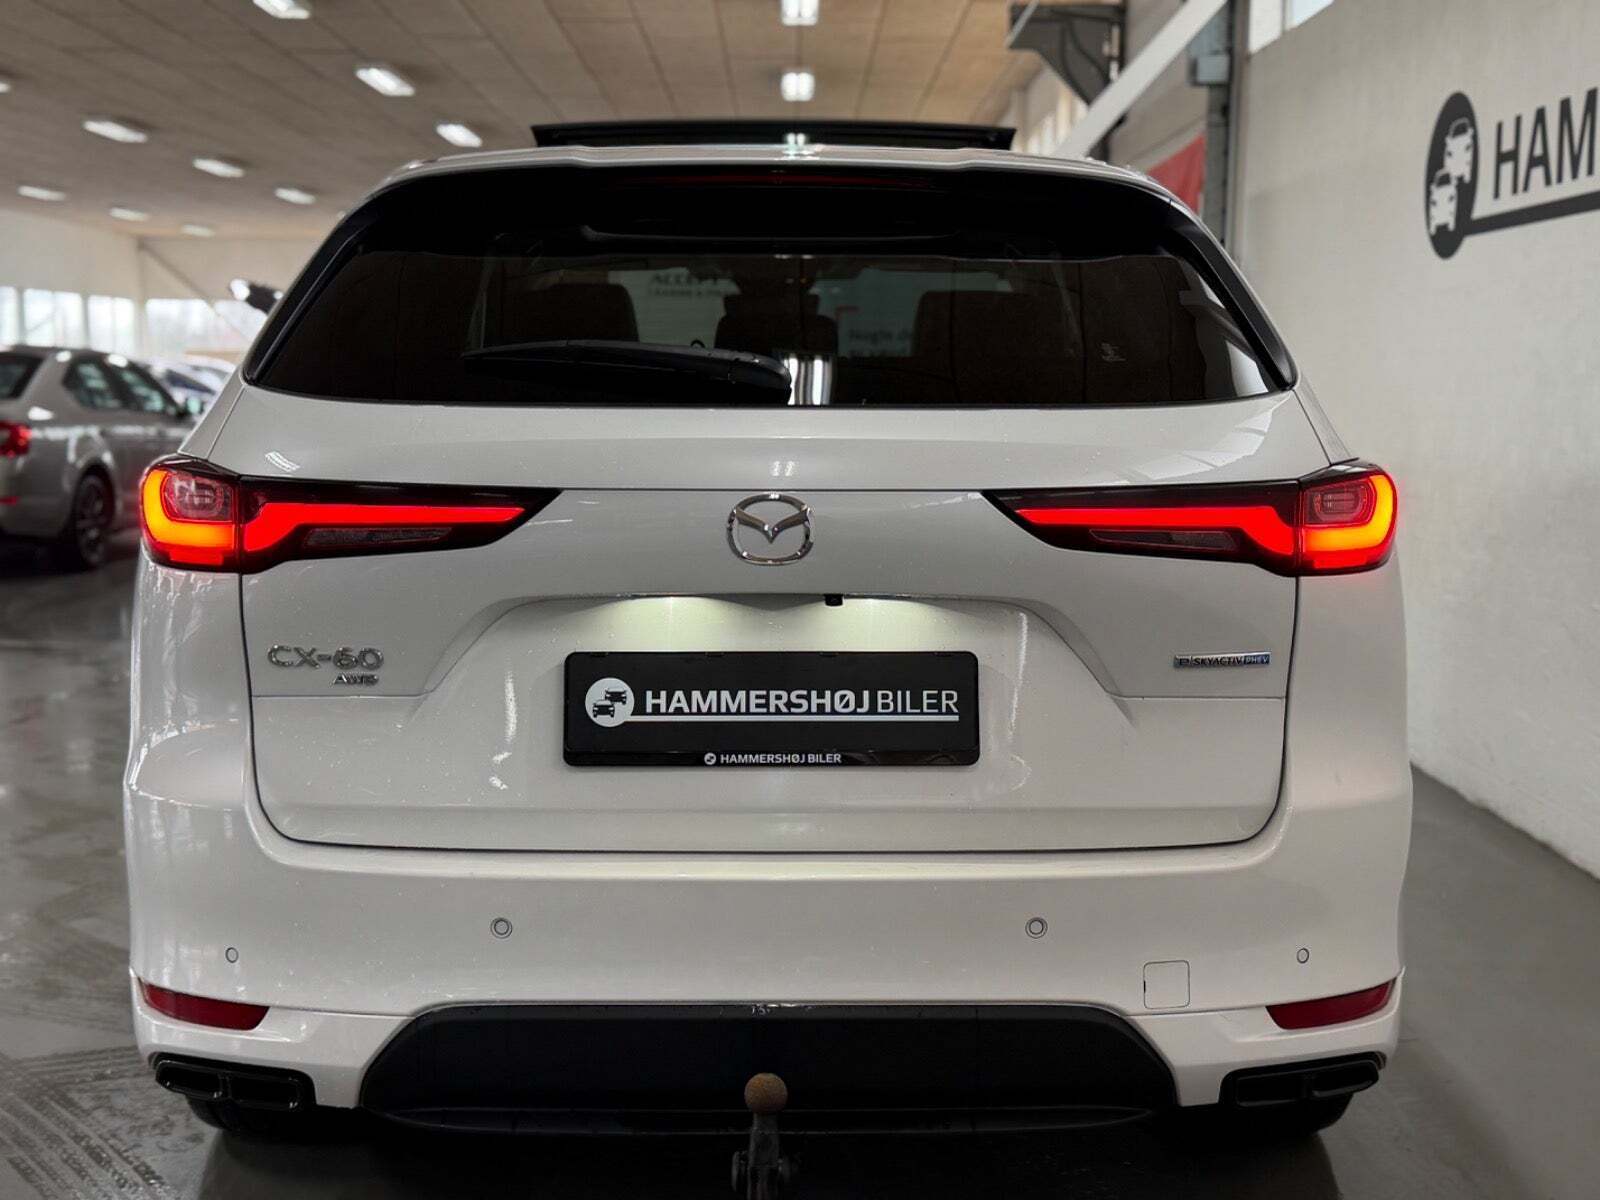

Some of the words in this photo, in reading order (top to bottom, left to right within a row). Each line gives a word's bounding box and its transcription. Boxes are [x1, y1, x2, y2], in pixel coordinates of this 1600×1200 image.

[1493, 87, 1598, 201] HAM
[267, 645, 384, 671] CX-60
[645, 690, 870, 713] HAMMERSHØJ
[877, 690, 959, 713] BILER
[720, 753, 805, 764] HAMMERSHØJ
[807, 753, 841, 764] BILER
